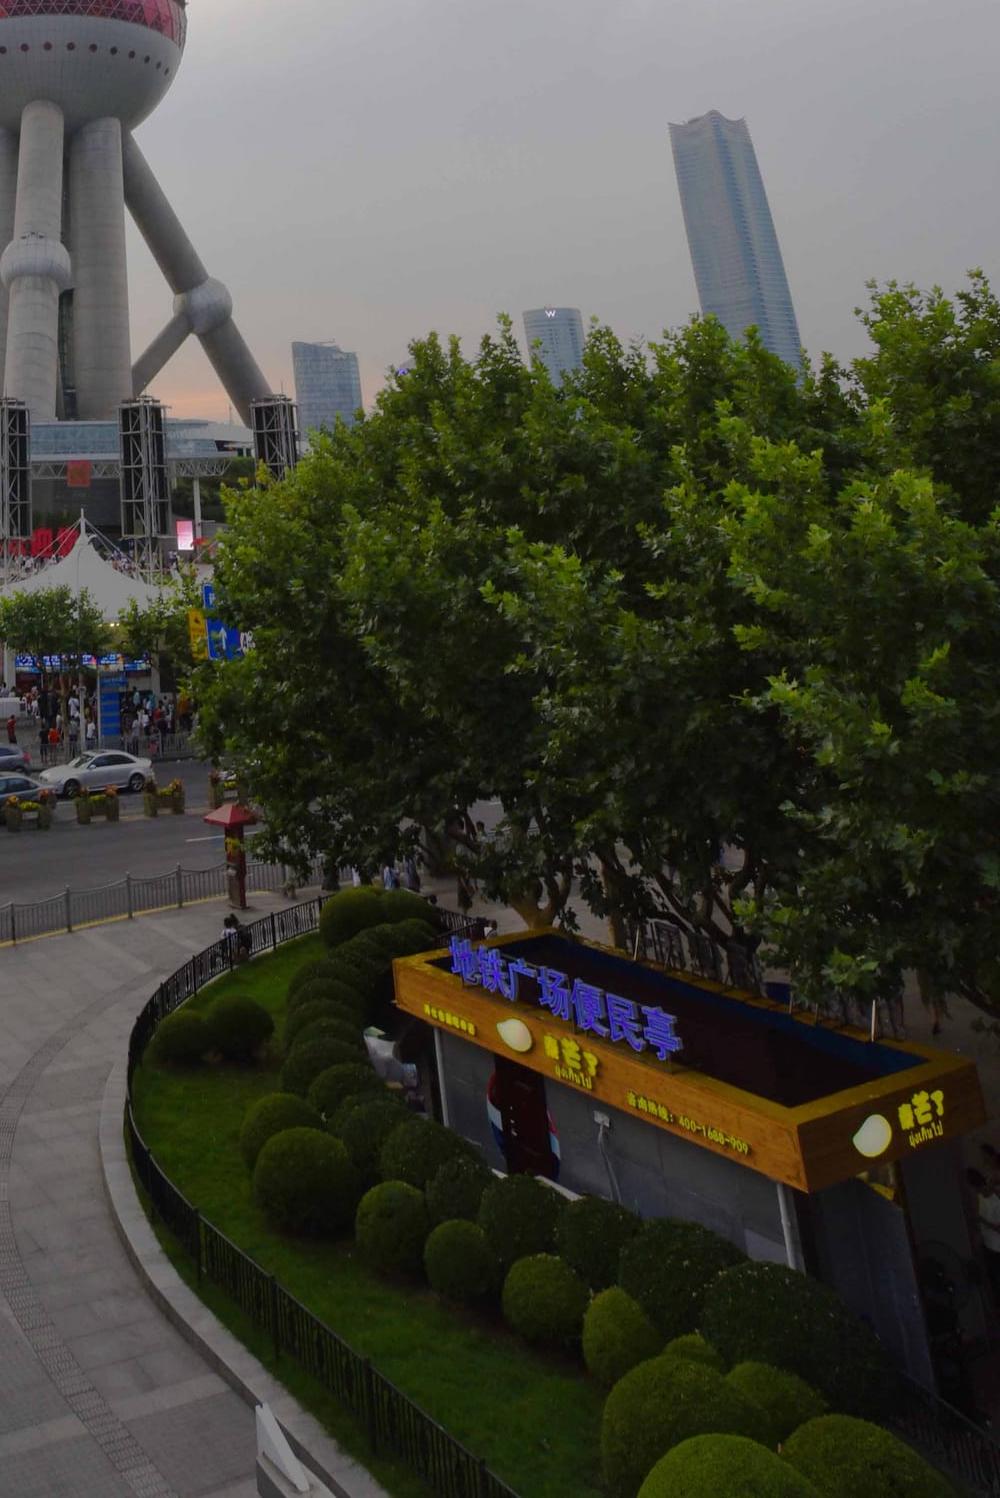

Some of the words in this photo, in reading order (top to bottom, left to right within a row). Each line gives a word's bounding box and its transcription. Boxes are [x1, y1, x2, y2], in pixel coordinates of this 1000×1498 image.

[449, 935, 683, 1061] 地铁广场便民亭
